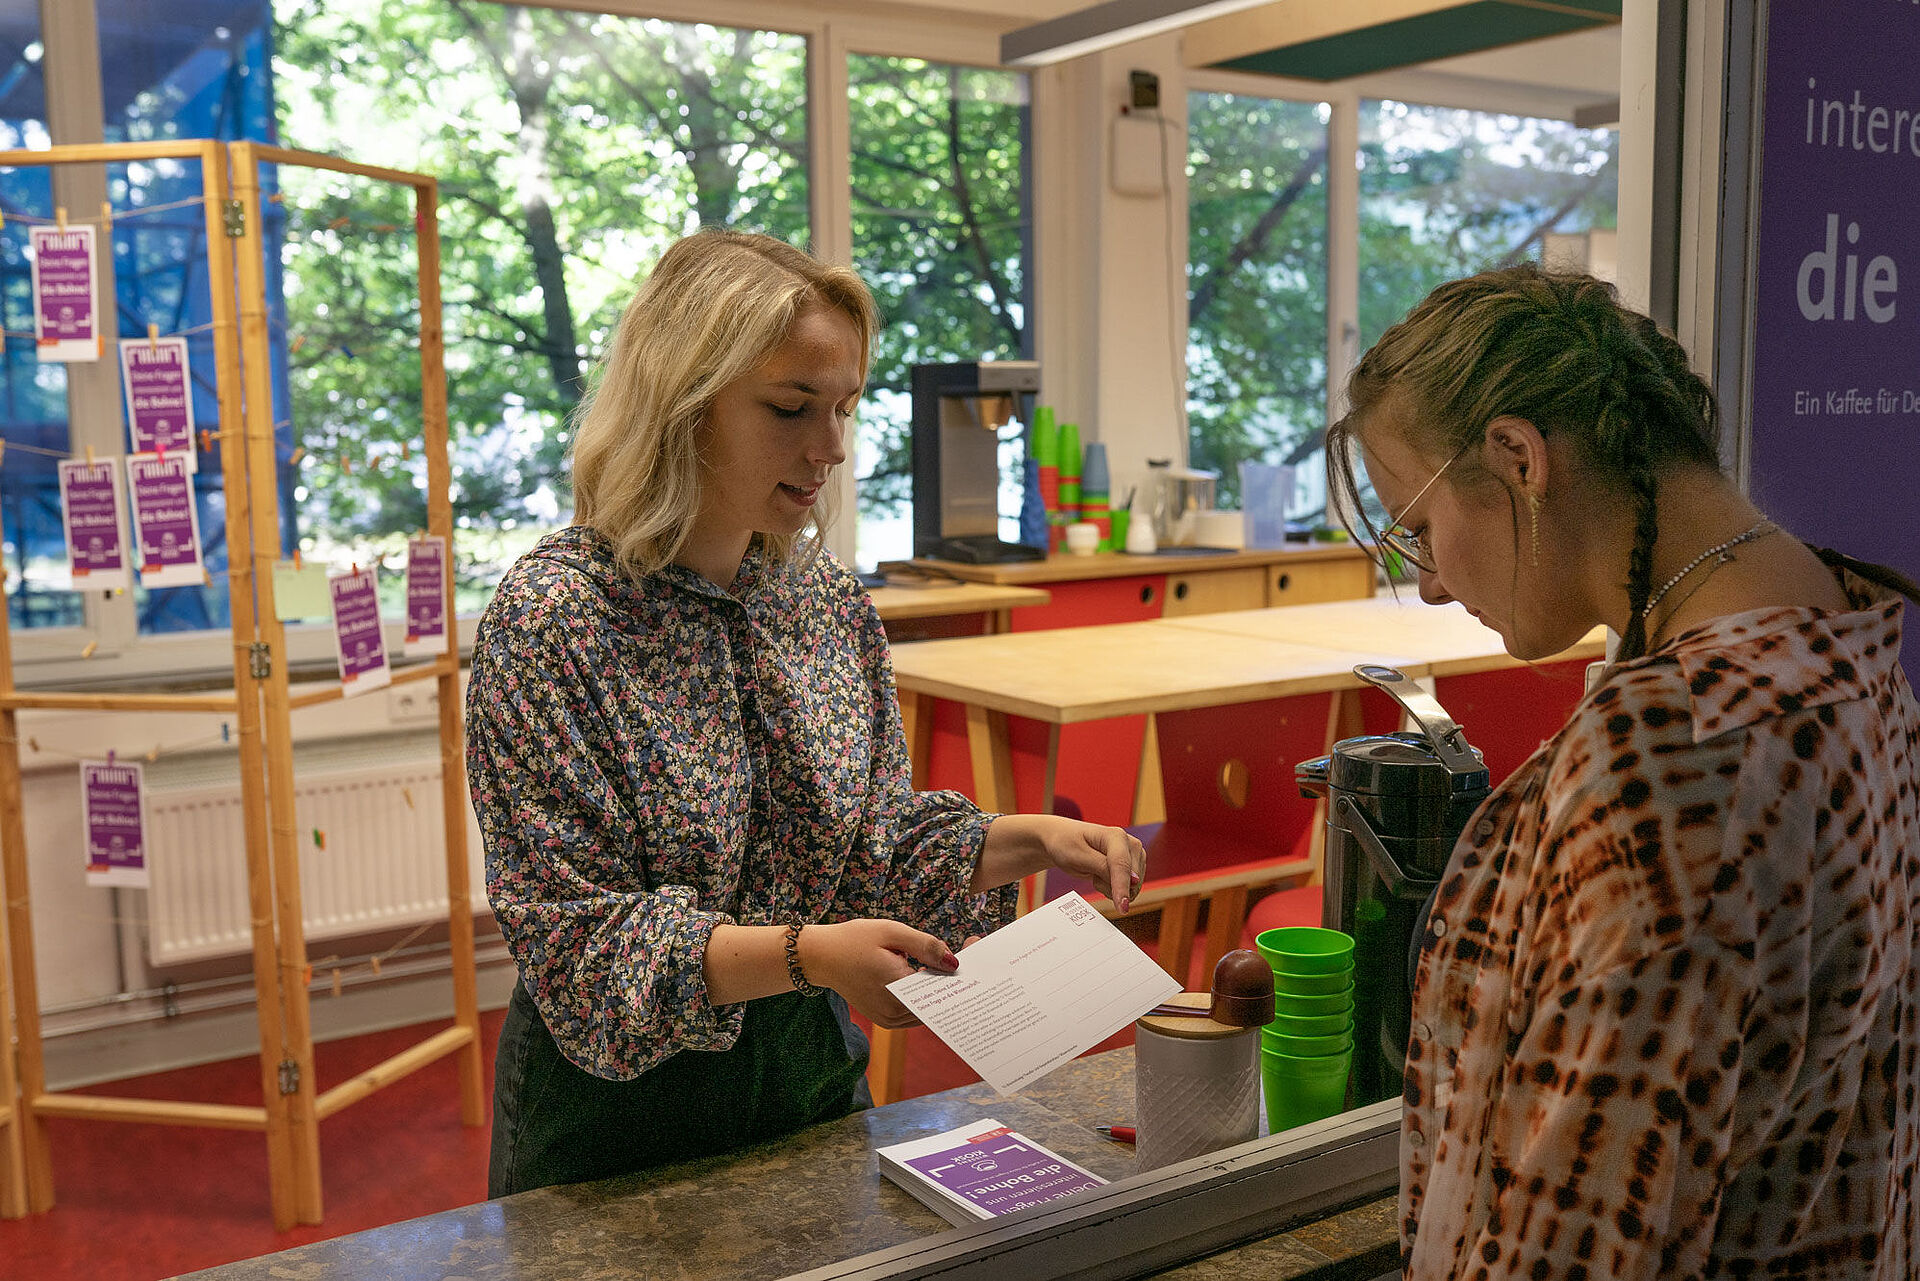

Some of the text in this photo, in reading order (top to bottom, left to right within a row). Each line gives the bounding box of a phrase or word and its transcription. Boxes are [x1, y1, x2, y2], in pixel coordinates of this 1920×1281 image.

[1797, 213, 1897, 323] die
[1795, 391, 1820, 415] Ein
[1825, 388, 1873, 415] Kaffee
[1876, 388, 1899, 414] für
[950, 1150, 986, 1164] KIOSK
[1033, 1164, 1061, 1178] die
[965, 1174, 1035, 1199] Bohne!
[1053, 1181, 1099, 1200] Deine
